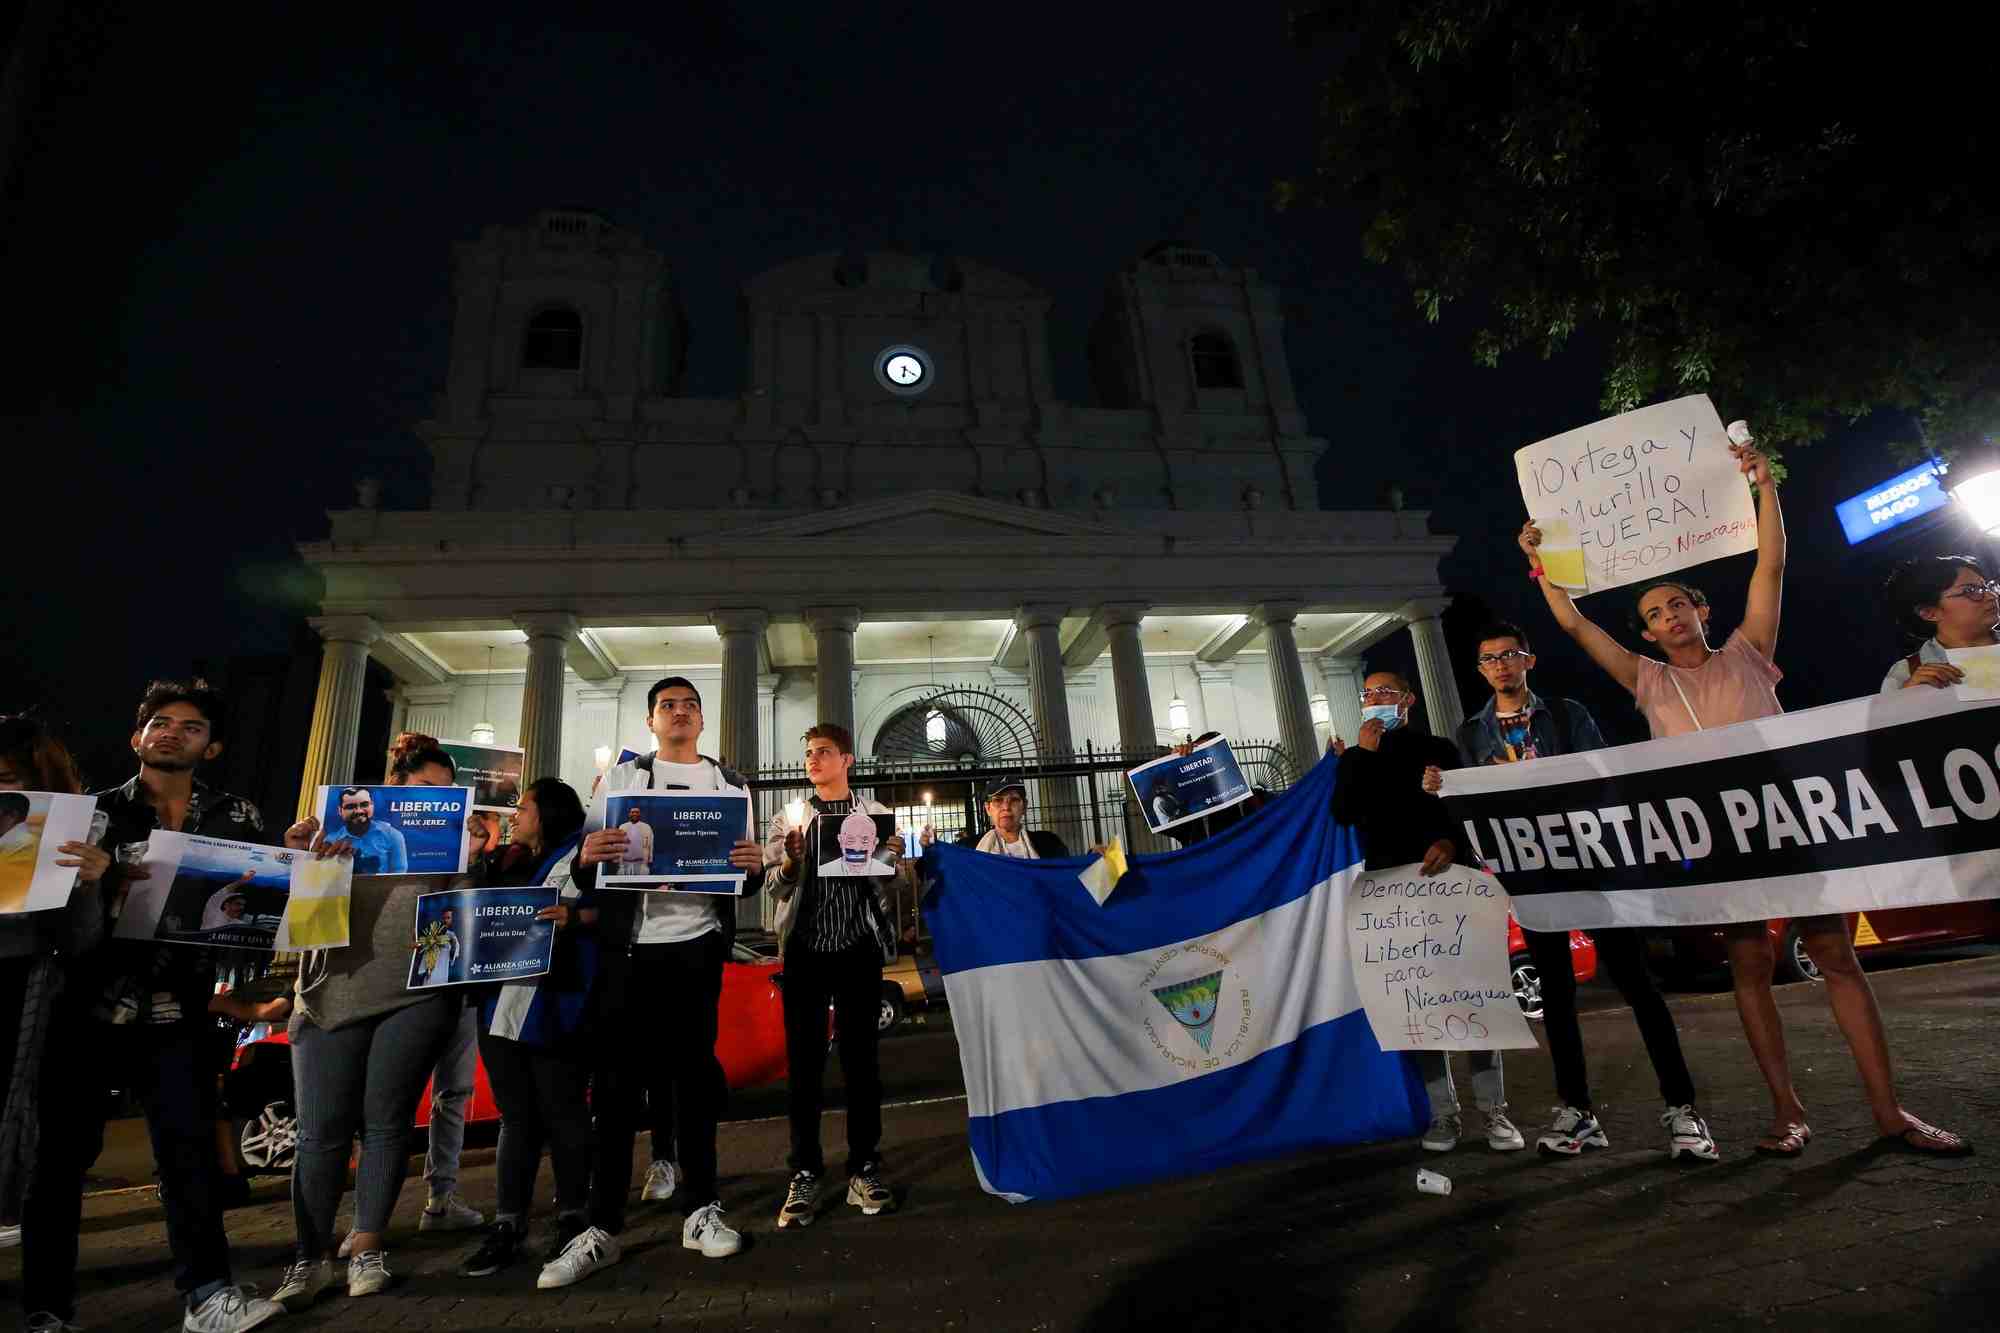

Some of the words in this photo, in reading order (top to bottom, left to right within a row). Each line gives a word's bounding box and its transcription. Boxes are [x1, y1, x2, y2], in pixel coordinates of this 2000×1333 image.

[1600, 542, 1672, 576] #SOS
[1179, 756, 1215, 774] LIBERTAD
[390, 801, 462, 812] LIBERTAD
[673, 811, 722, 821] LIBERTAD
[1464, 797, 1712, 874] LIBERTAD
[1720, 768, 1899, 854] PARA
[1898, 743, 2000, 829] LO
[403, 819, 421, 827] MAX
[422, 819, 448, 827] JEREZ
[1361, 879, 1495, 899] Democracia
[475, 905, 534, 917] LIBERTAD
[1356, 905, 1444, 931] Justicia
[1364, 933, 1463, 964] Libertad
[484, 962, 515, 970] ALIANZA
[1384, 965, 1432, 995] para
[1405, 983, 1511, 1013] Nicaragua
[1404, 1012, 1489, 1044] #SOS
[1202, 1056, 1220, 1069] DE
